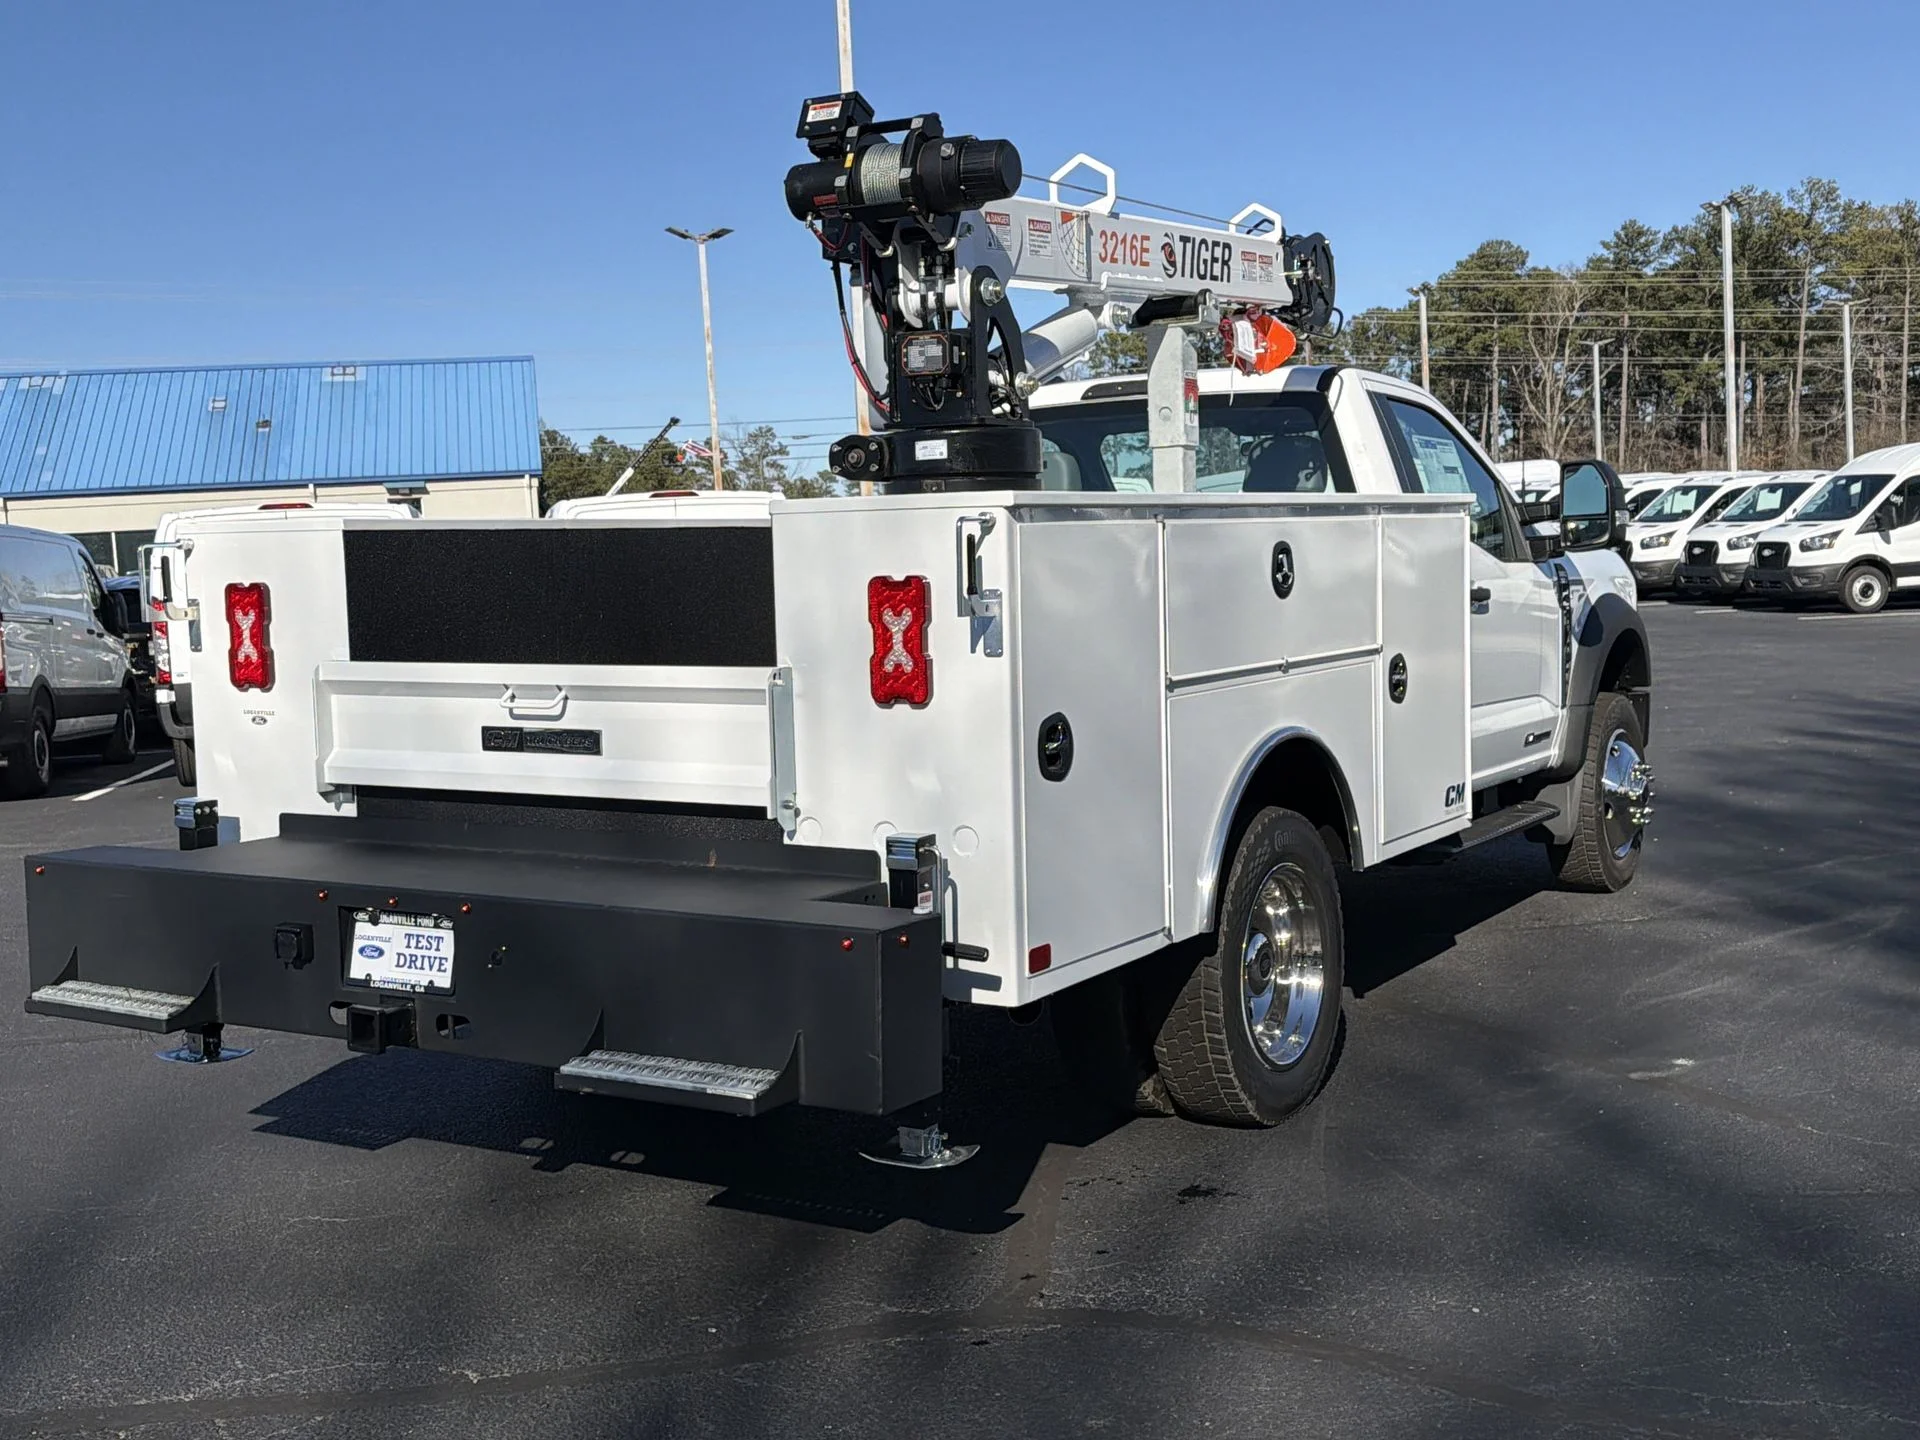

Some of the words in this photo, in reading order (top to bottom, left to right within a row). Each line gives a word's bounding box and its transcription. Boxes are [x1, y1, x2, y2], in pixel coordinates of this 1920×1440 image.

[1099, 229, 1150, 267] 3216E
[1179, 235, 1232, 283] TIGER
[1445, 782, 1465, 807] CM
[355, 934, 392, 943] LOGANVILLE
[404, 933, 444, 952] TEST
[360, 946, 383, 959] Ford
[395, 952, 448, 973] DRIVE
[414, 985, 425, 993] GA
